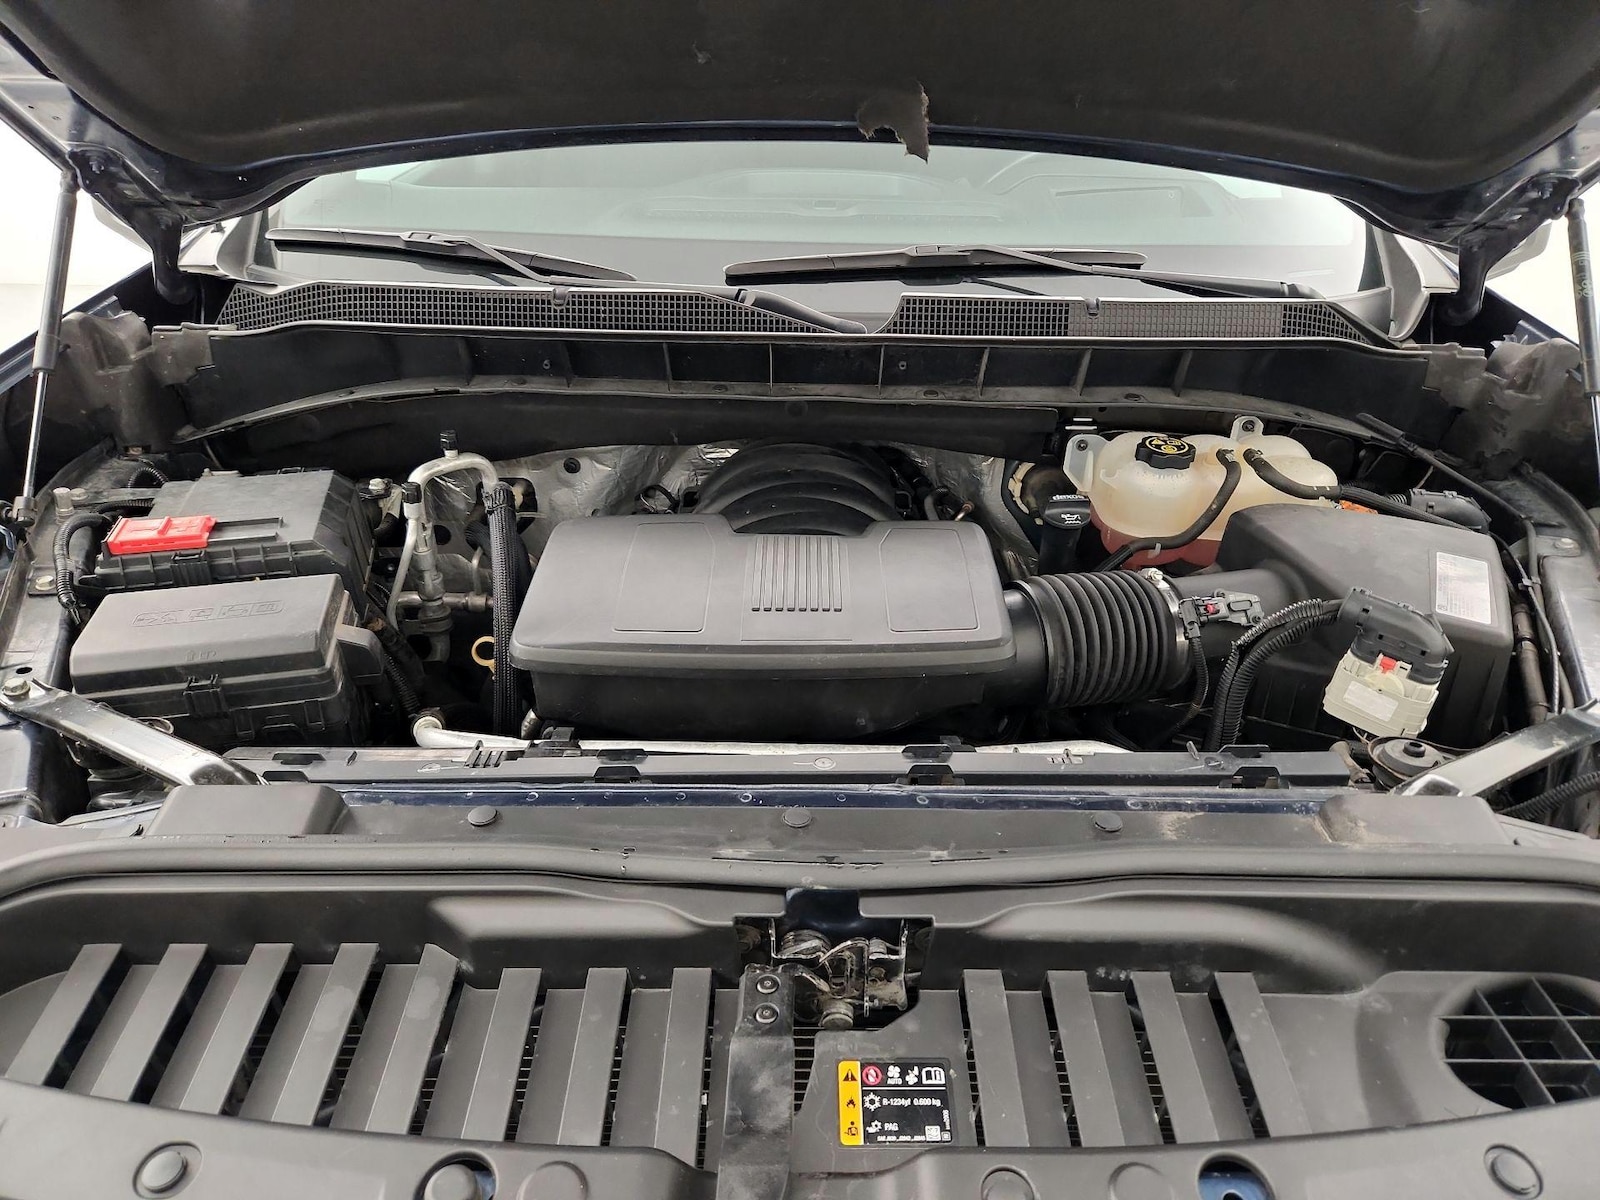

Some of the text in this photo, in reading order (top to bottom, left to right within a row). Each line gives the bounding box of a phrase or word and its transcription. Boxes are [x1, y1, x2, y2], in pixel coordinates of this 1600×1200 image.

[886, 1077, 903, 1085] AUTO
[882, 1097, 941, 1107] R-1234yf 0.600 kg
[884, 1122, 899, 1131] PAG
